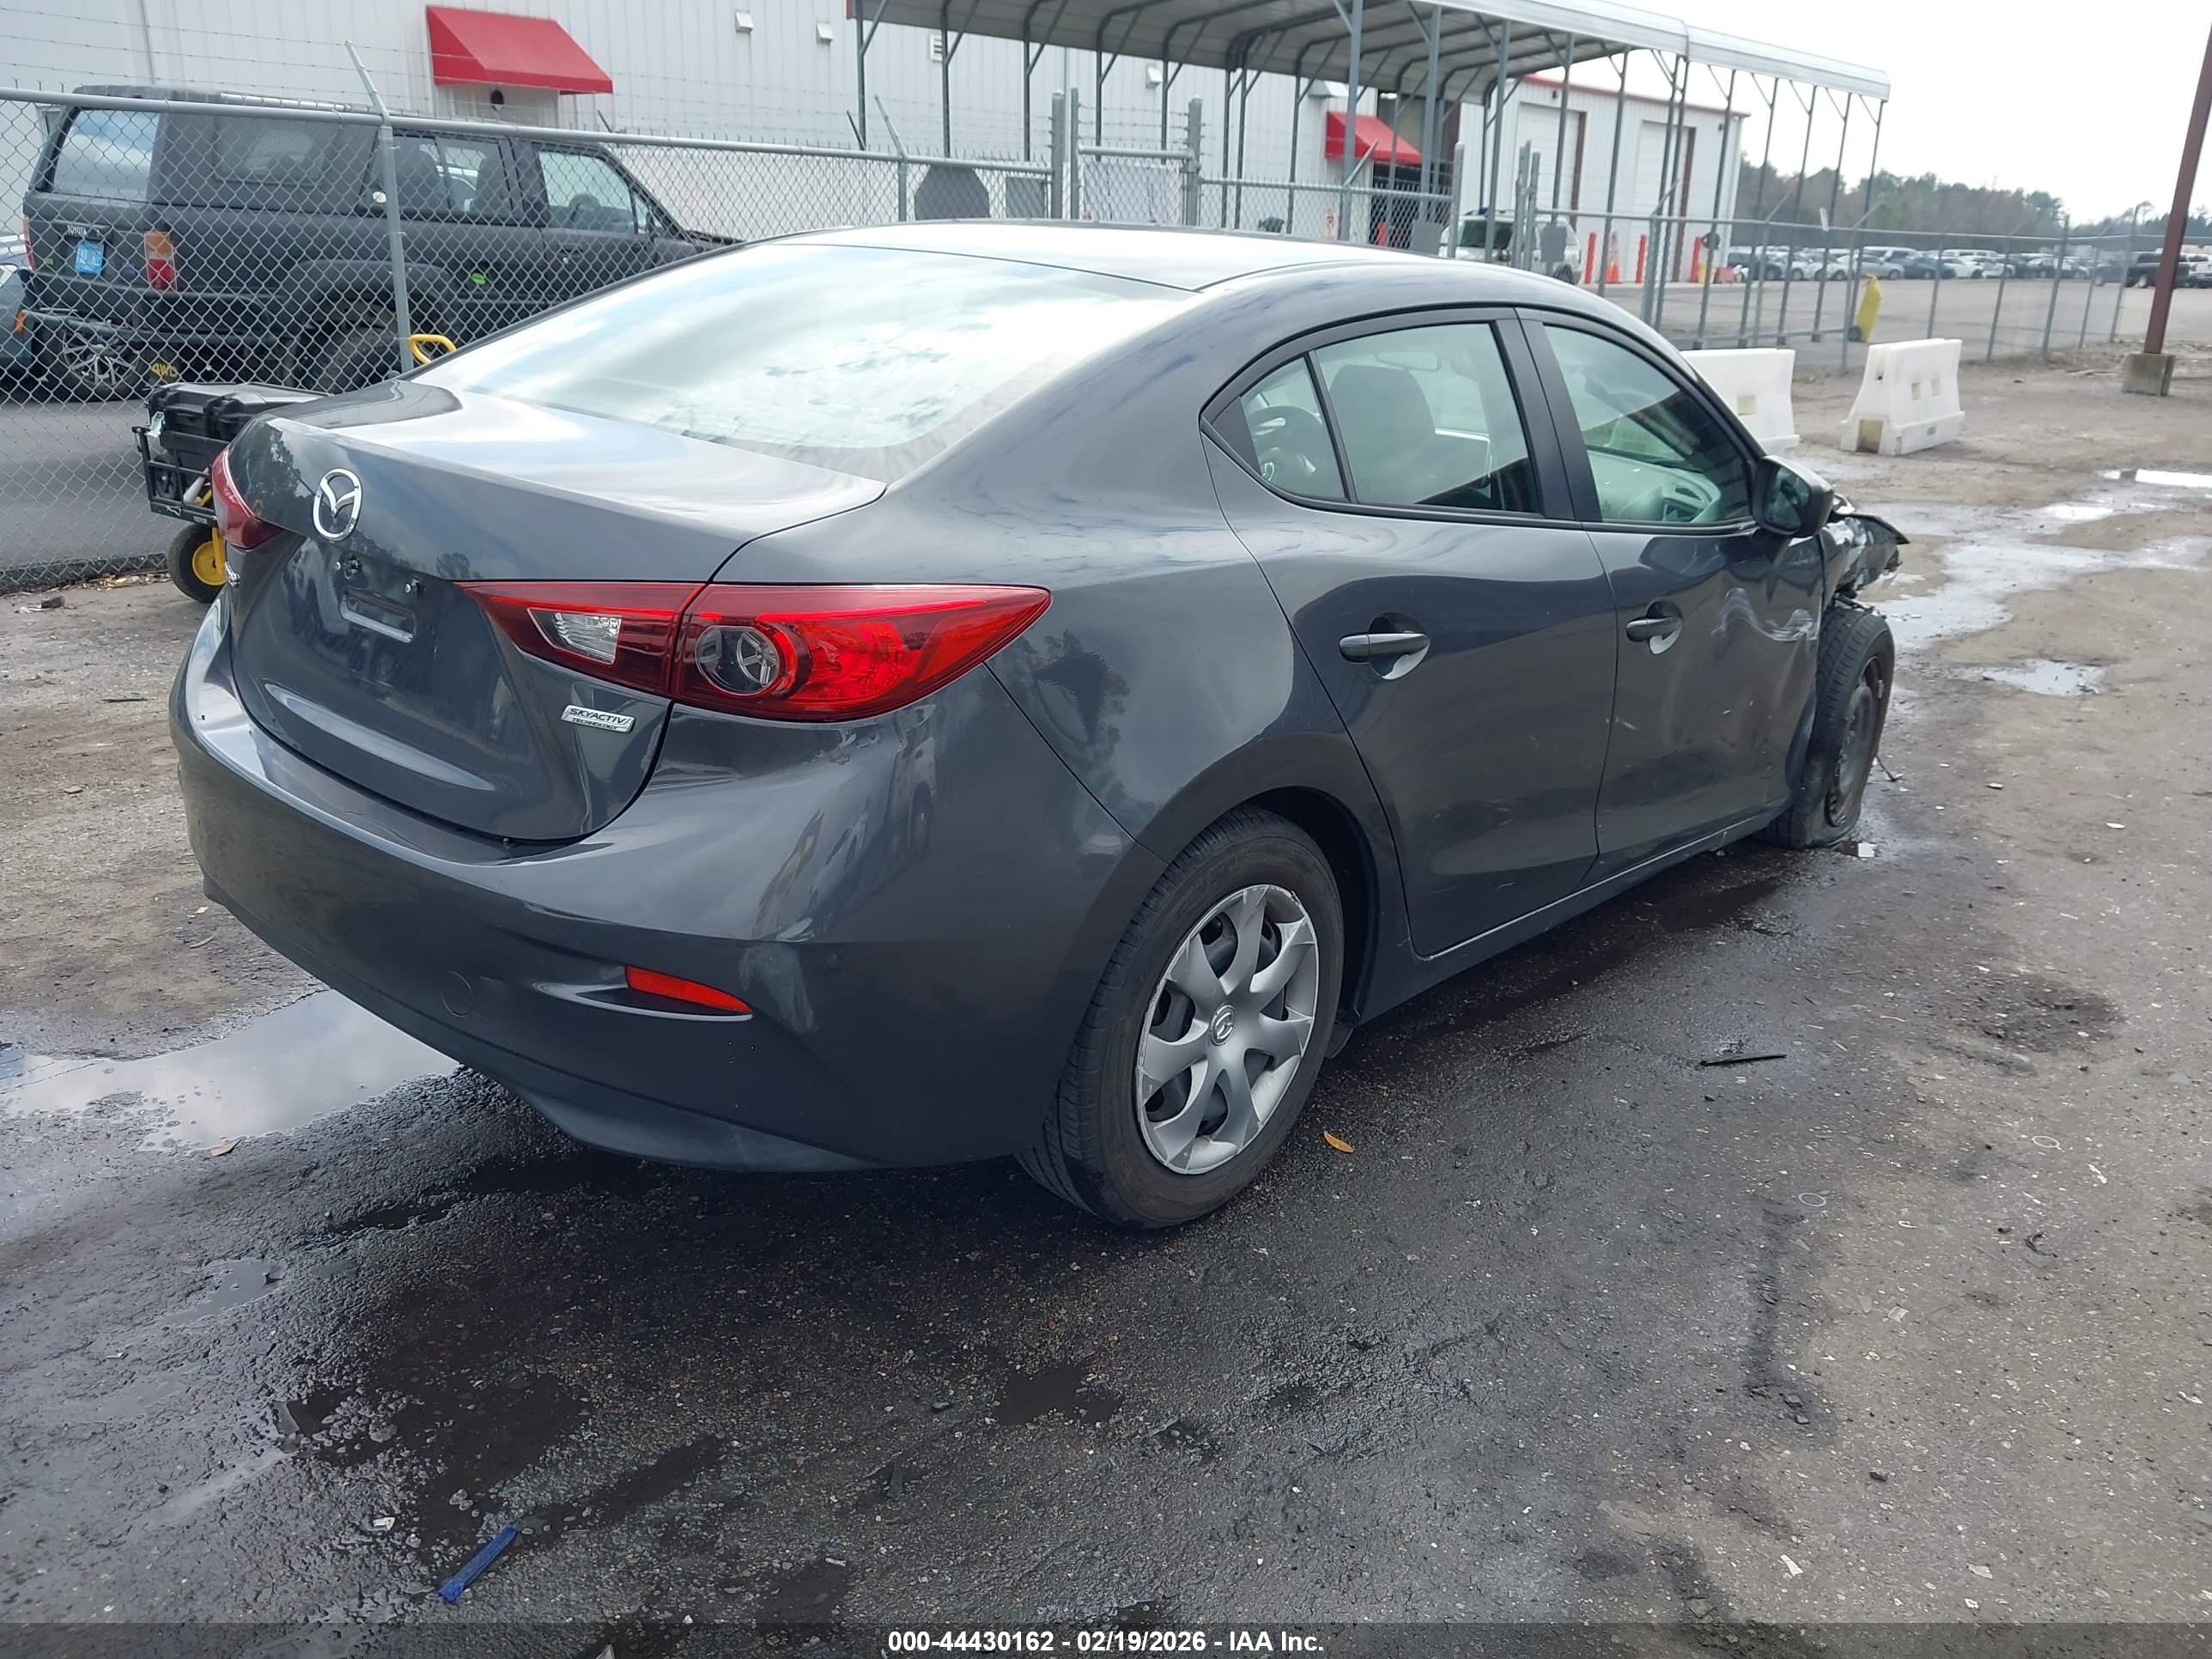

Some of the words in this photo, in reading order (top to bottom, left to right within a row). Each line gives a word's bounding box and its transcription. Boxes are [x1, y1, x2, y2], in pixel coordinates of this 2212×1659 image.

[67, 224, 88, 236] TOYOTA
[151, 362, 179, 378] 4WD
[570, 708, 628, 724] SKYACTIV
[573, 717, 619, 730] TECHNOLOGY
